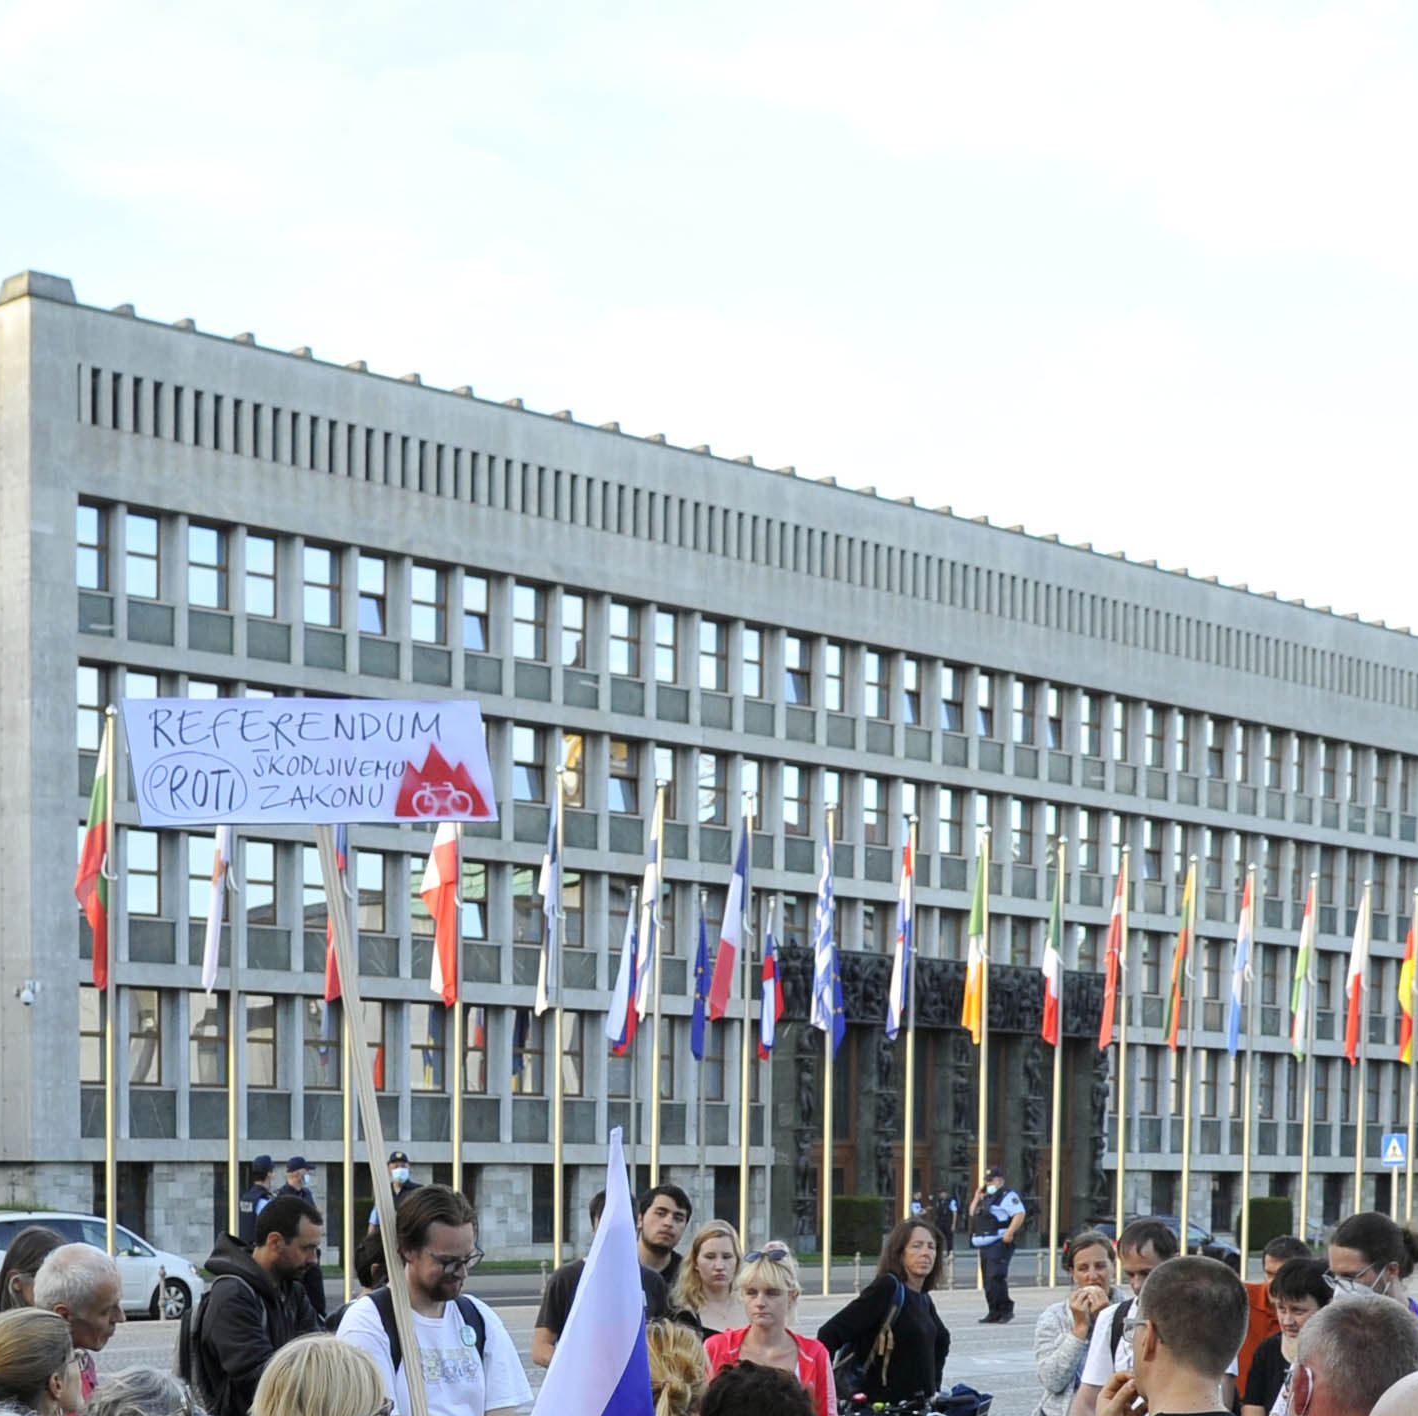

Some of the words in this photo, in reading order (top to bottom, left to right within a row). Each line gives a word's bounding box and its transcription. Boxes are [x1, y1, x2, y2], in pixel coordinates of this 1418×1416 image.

[148, 708, 442, 748] REFERENDUM
[148, 763, 236, 812] PROTI
[259, 783, 384, 811] ZAKONU
